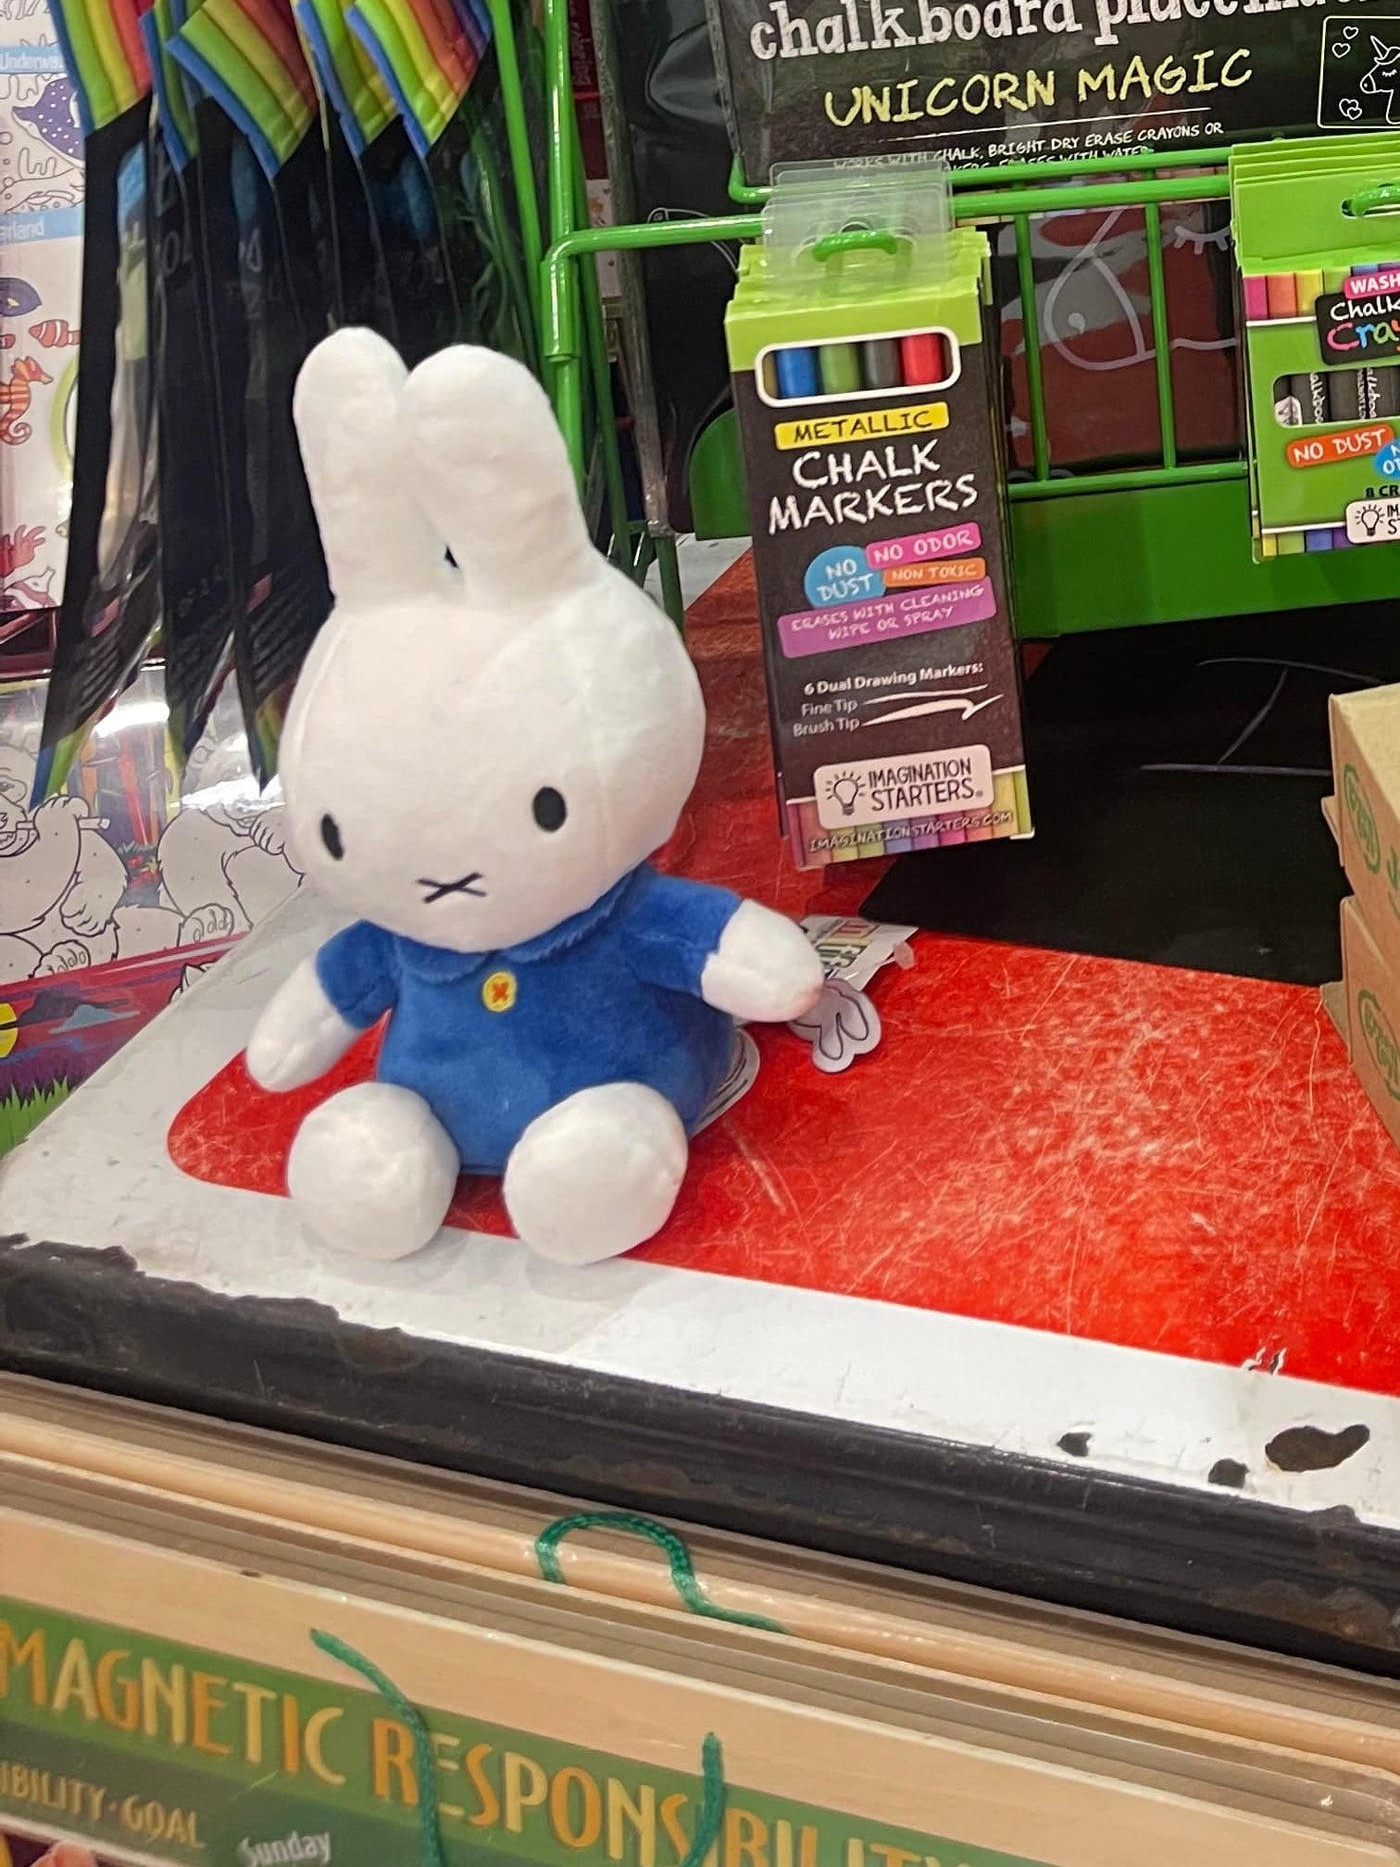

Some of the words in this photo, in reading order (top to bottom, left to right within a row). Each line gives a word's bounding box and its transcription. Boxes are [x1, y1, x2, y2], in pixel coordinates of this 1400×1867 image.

[824, 69, 1056, 128] UNICORN
[1077, 48, 1253, 104] MAGIC
[988, 140, 1045, 159] BRIGHT
[1051, 136, 1080, 151] DRY
[1085, 130, 1133, 146] ERASE
[1137, 126, 1201, 142] CRAYONS
[1205, 122, 1224, 135] OR
[794, 410, 933, 444] METALLIC
[793, 438, 941, 488] CHALK
[1293, 443, 1324, 464] NO
[1333, 429, 1385, 453] DUST
[768, 473, 978, 535] MARKERS
[873, 544, 904, 564] NO
[914, 529, 974, 557] ODOR
[825, 559, 857, 578] NO
[892, 567, 923, 580] NON
[928, 562, 977, 578] TOXIC
[816, 574, 875, 602] DUST
[791, 612, 849, 632] ERASES
[853, 602, 894, 621] WITH
[900, 583, 985, 610] CLEANING
[828, 624, 870, 641] WIPE
[877, 618, 899, 630] OR
[904, 606, 954, 626] SPRAY
[817, 677, 851, 693] Dual
[855, 670, 917, 689] Drawing
[920, 662, 984, 682] Markers:
[802, 701, 832, 717] Fine
[834, 698, 858, 713] Tip
[793, 720, 834, 737] Brush
[836, 716, 860, 734] Tip
[868, 757, 971, 788] IMAGINATION
[808, 810, 1013, 853] IMAGINATIONSTARTERS.COM
[0, 1619, 346, 1786] MAGNETIC
[236, 1832, 332, 1867] Sunday
